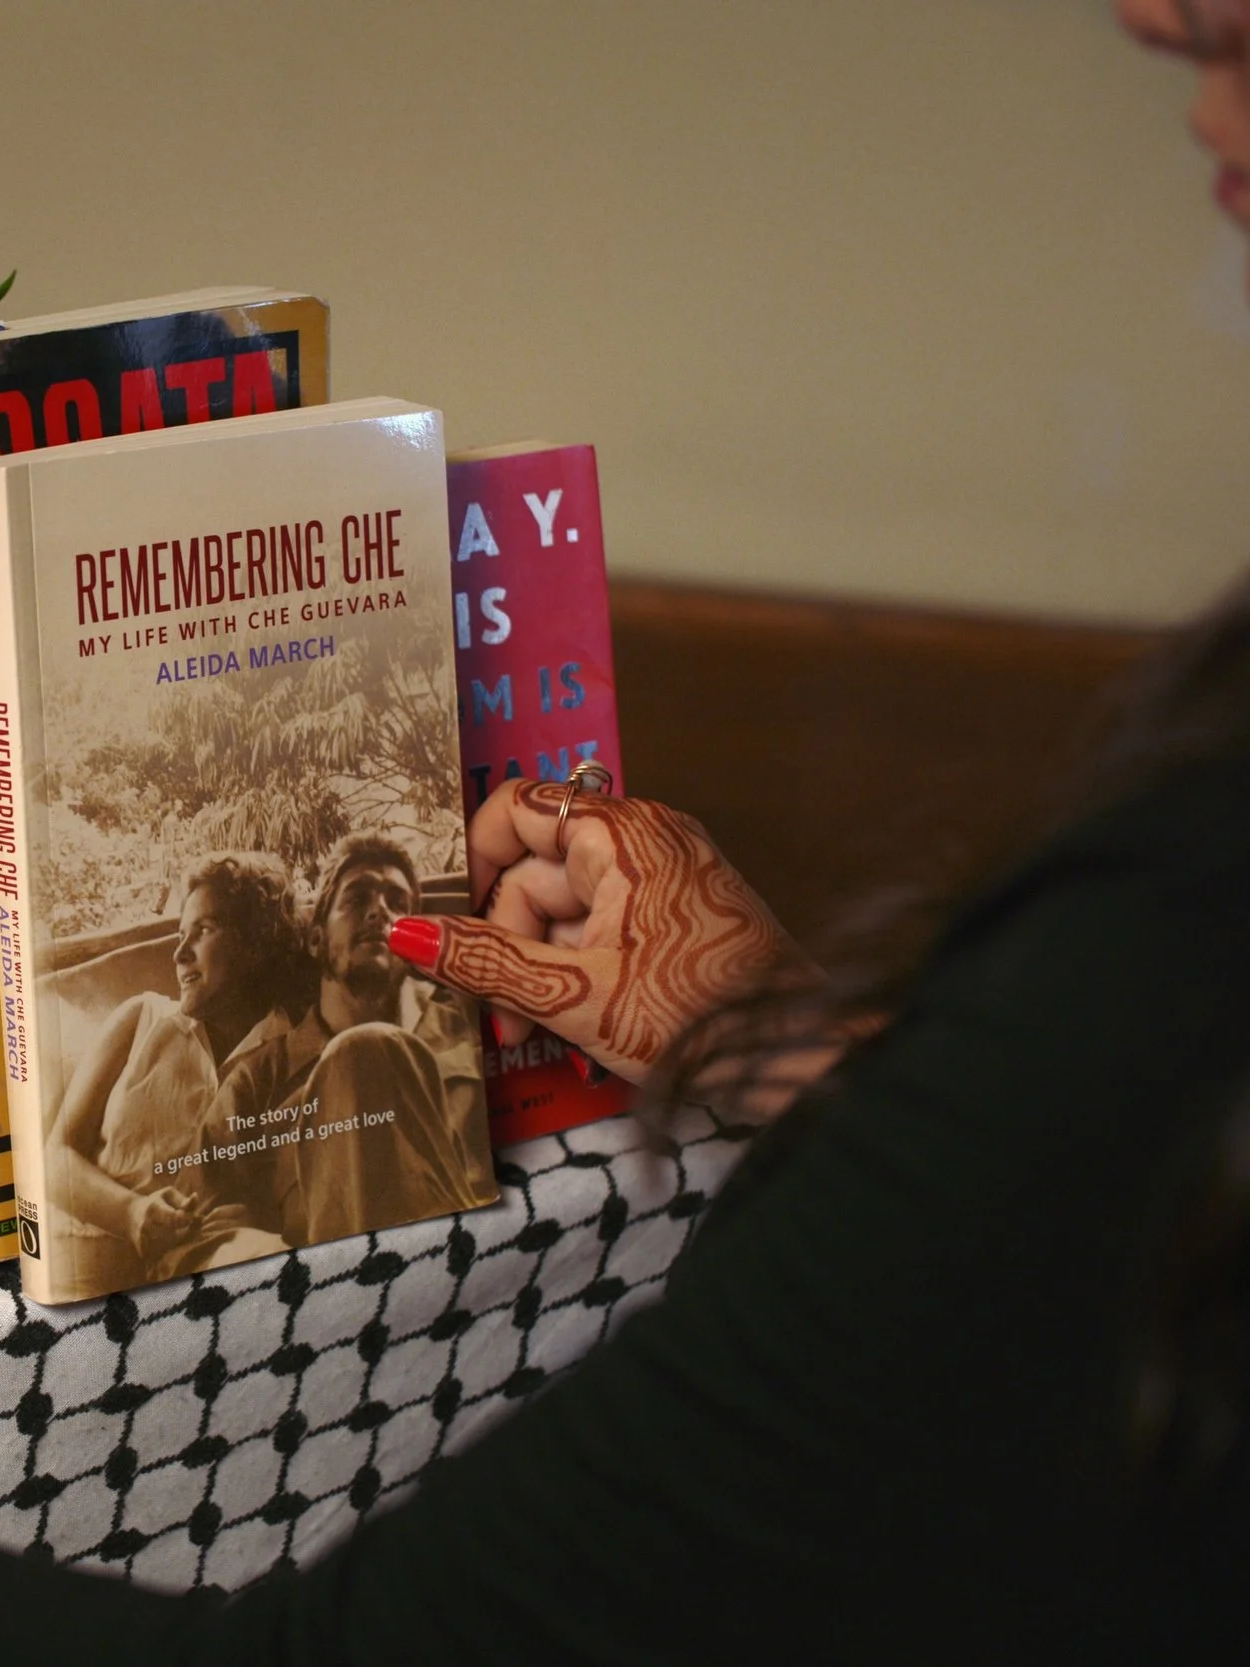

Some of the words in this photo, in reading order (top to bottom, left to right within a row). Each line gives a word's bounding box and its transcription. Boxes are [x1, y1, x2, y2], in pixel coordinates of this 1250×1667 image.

[523, 488, 578, 547] Y.
[75, 520, 326, 625] REMEMBERING
[341, 509, 404, 585] CHE
[78, 635, 112, 658] MY
[123, 626, 168, 650] LIFE
[179, 615, 237, 640] WITH
[248, 607, 290, 630] CHE
[301, 590, 407, 621] GUEVARA
[156, 651, 240, 685] ALEIDA
[250, 635, 335, 669] MARCH
[538, 661, 586, 713] IS
[0, 905, 13, 986] ALEIDA
[11, 910, 20, 930] MY
[12, 933, 21, 958] LIFE
[14, 962, 23, 993] WITH
[16, 998, 25, 1021] CHE
[5, 996, 19, 1080] MARCH
[18, 1025, 28, 1082] GUEVARA
[154, 1162, 163, 1175] a
[168, 1149, 209, 1175] great
[213, 1135, 267, 1161] legend
[271, 1127, 300, 1148] and
[305, 1127, 315, 1140] a
[318, 1114, 360, 1140] great
[363, 1108, 396, 1128] love
[226, 1113, 257, 1132] The
[259, 1105, 299, 1125] story
[303, 1098, 320, 1116] of
